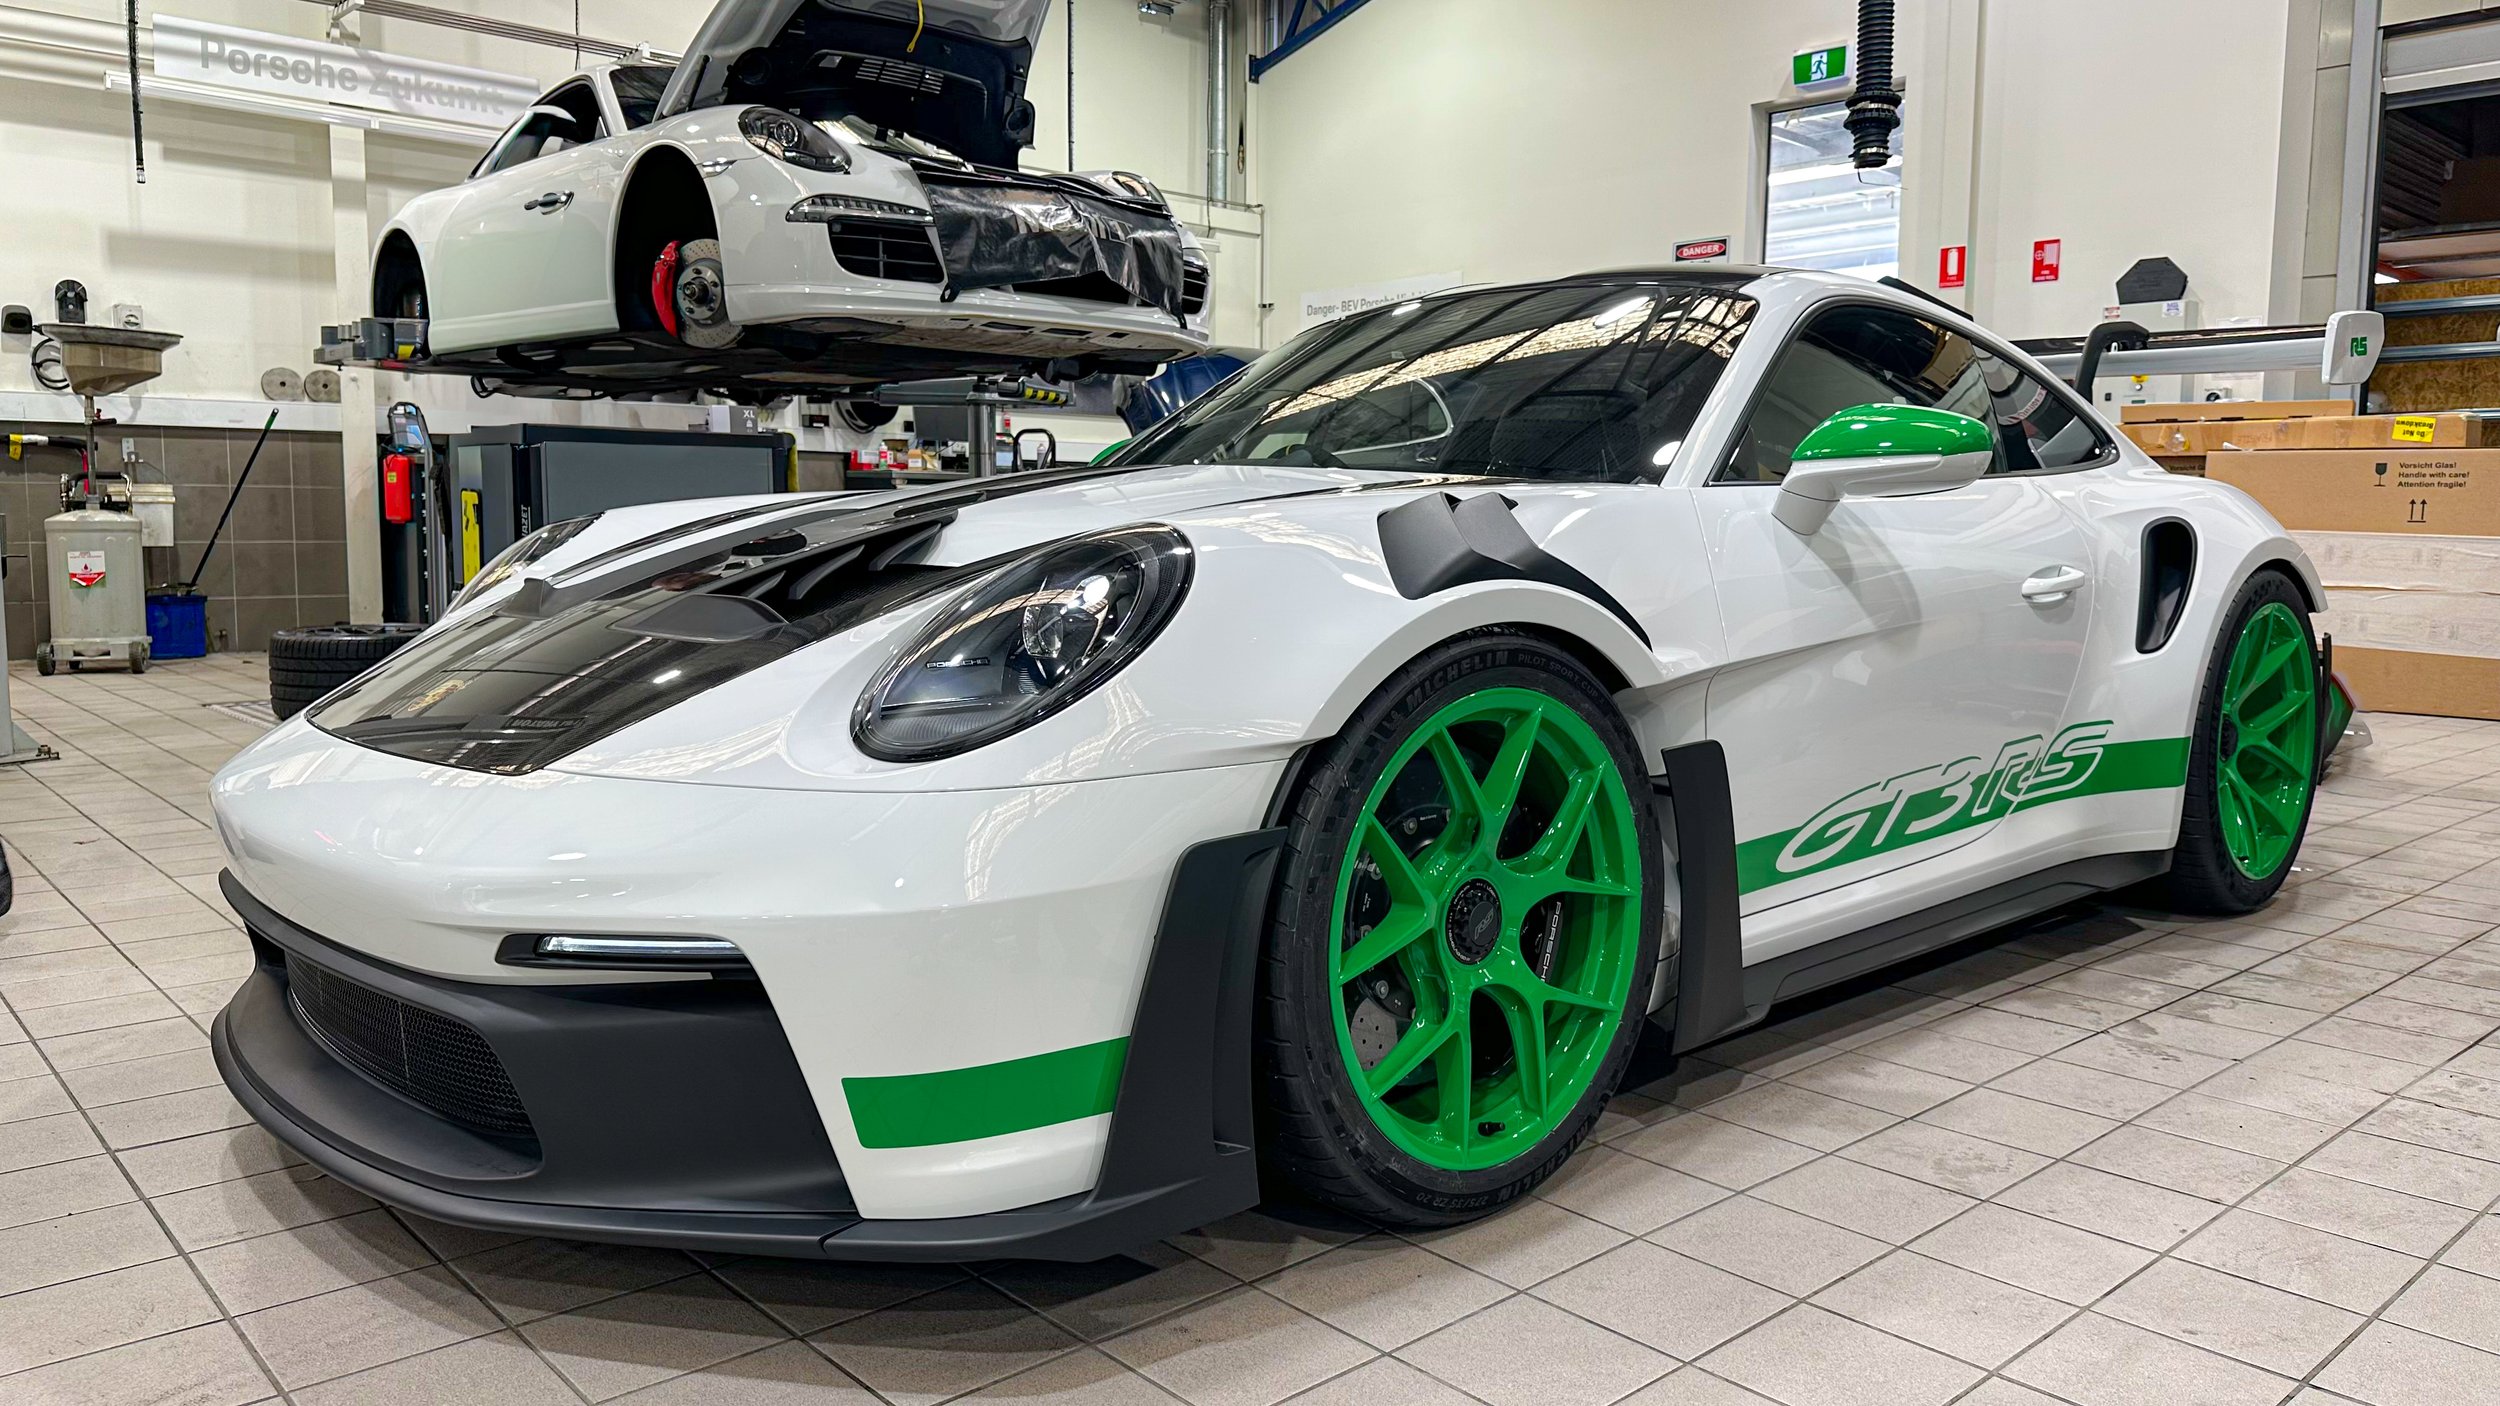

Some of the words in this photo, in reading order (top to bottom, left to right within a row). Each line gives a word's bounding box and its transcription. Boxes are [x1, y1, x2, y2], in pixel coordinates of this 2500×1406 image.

[201, 36, 359, 93] Porsche
[369, 64, 504, 116] Zukunft
[1682, 244, 1720, 257] DANGER
[1306, 304, 1340, 317] Danger-
[1341, 299, 1360, 312] BEV
[2350, 336, 2368, 357] RS
[743, 409, 755, 418] XL
[2395, 420, 2435, 429] Breakdown
[2437, 481, 2467, 489] fragile!
[1405, 650, 1510, 712] MICHELIN
[1517, 652, 1547, 666] PILOT
[1549, 661, 1580, 684] SPORT
[1581, 680, 1599, 698] CUP
[1541, 901, 1562, 983] PORSCH
[1497, 1121, 1589, 1203] MICHELIN
[1416, 1191, 1432, 1203] 20
[1433, 1197, 1450, 1208] ZR
